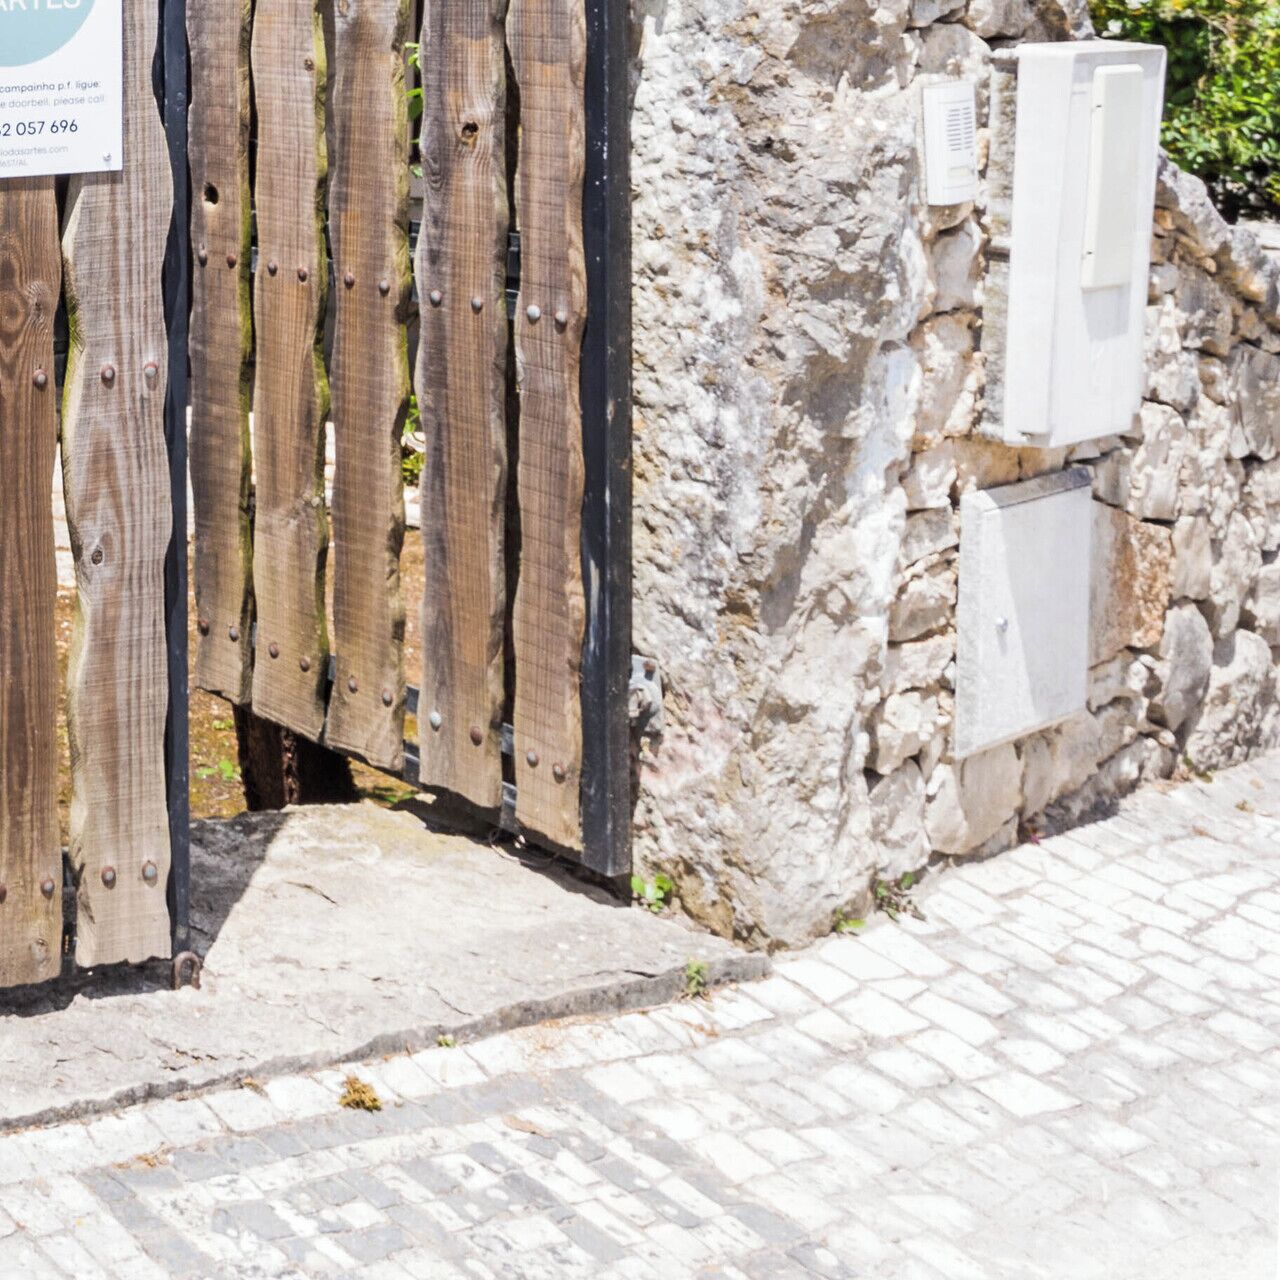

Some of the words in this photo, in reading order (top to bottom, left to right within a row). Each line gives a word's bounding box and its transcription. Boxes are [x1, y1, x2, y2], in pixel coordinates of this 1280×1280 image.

[53, 95, 85, 107] please
[16, 121, 45, 136] 057
[50, 119, 78, 135] 696
